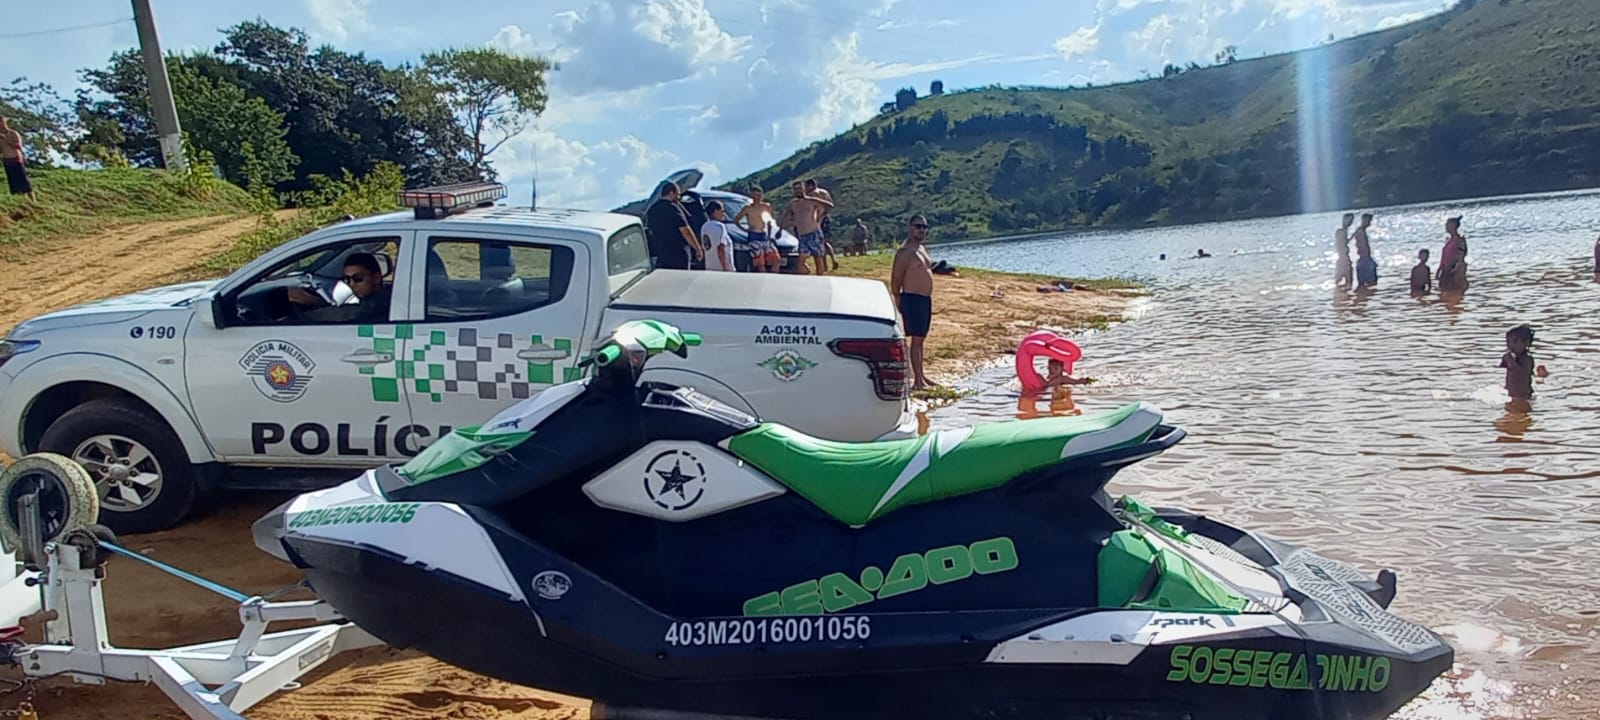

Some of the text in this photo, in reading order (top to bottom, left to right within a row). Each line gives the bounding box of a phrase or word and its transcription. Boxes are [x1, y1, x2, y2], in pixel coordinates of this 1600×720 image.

[147, 326, 176, 339] 190
[760, 325, 816, 336] A-03411
[754, 335, 822, 345] AMBIENTAL
[278, 343, 312, 369] MILITAR
[1149, 615, 1216, 629] spark
[664, 615, 871, 646] 403M2016001056
